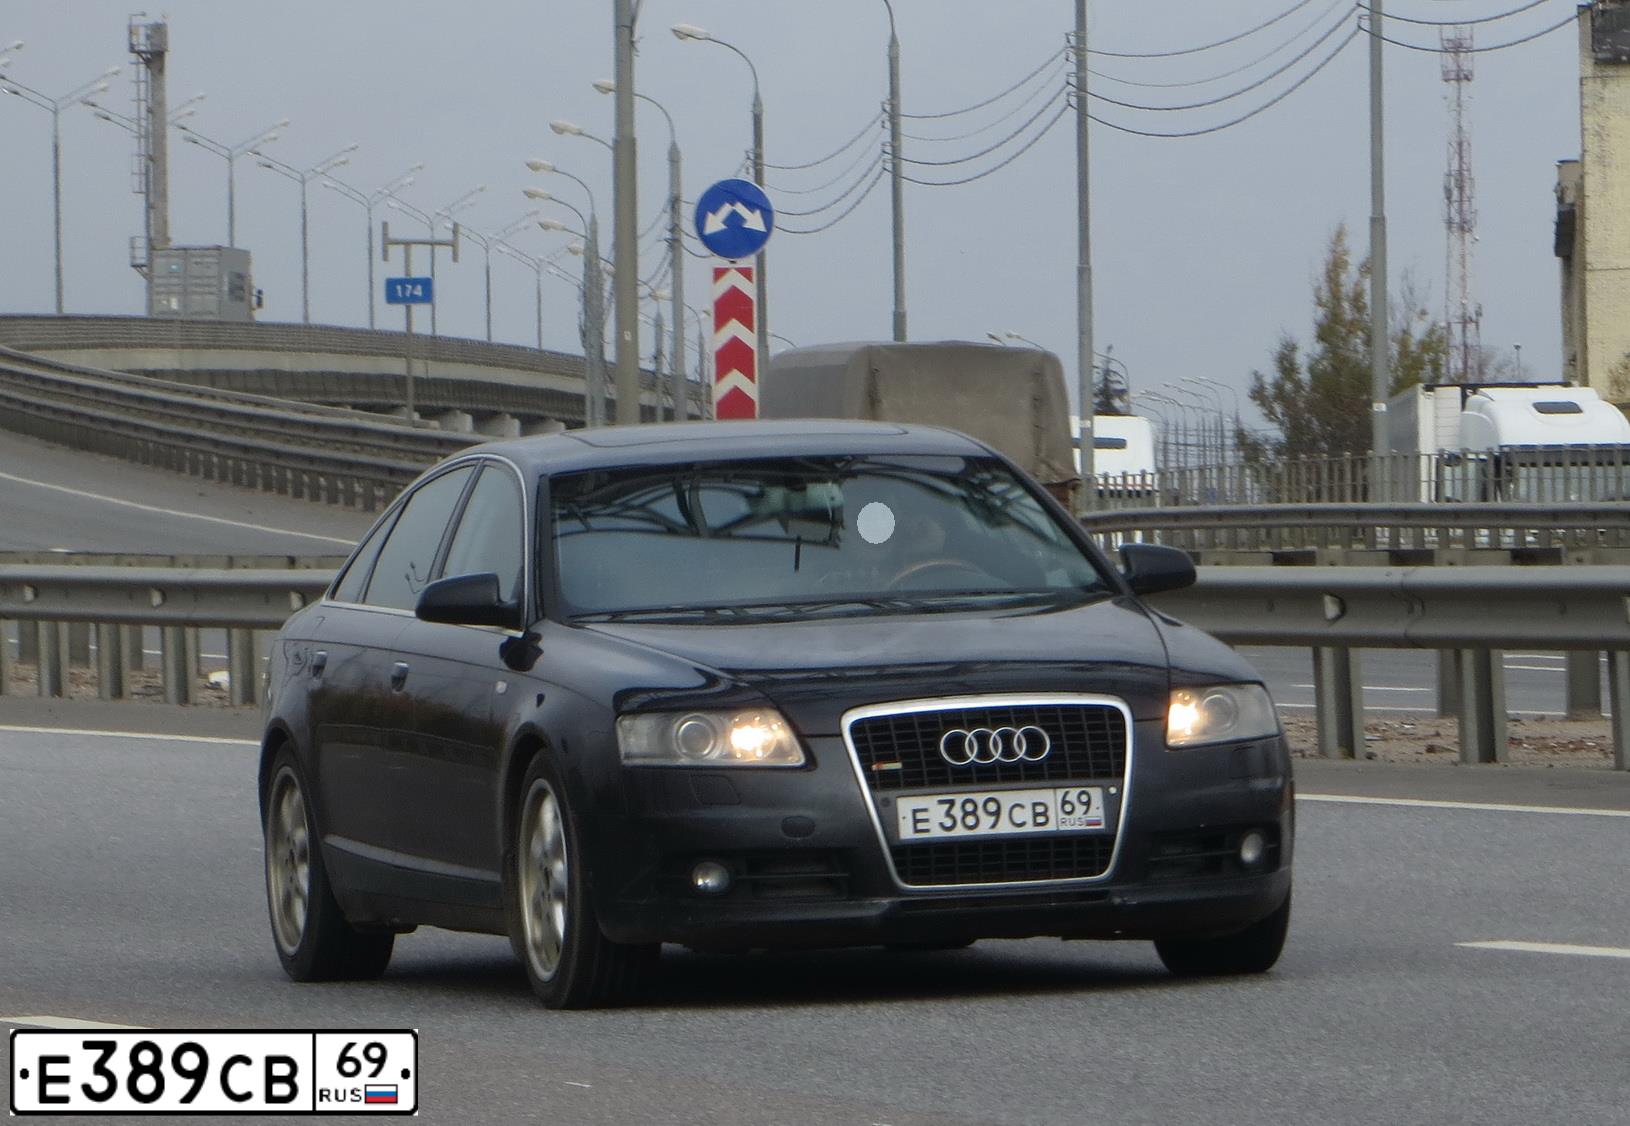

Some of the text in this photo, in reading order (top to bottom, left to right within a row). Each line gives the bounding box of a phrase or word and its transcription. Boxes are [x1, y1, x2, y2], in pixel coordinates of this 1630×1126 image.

[396, 284, 422, 298] 174
[1060, 789, 1092, 816] 69
[1060, 817, 1085, 827] RUS
